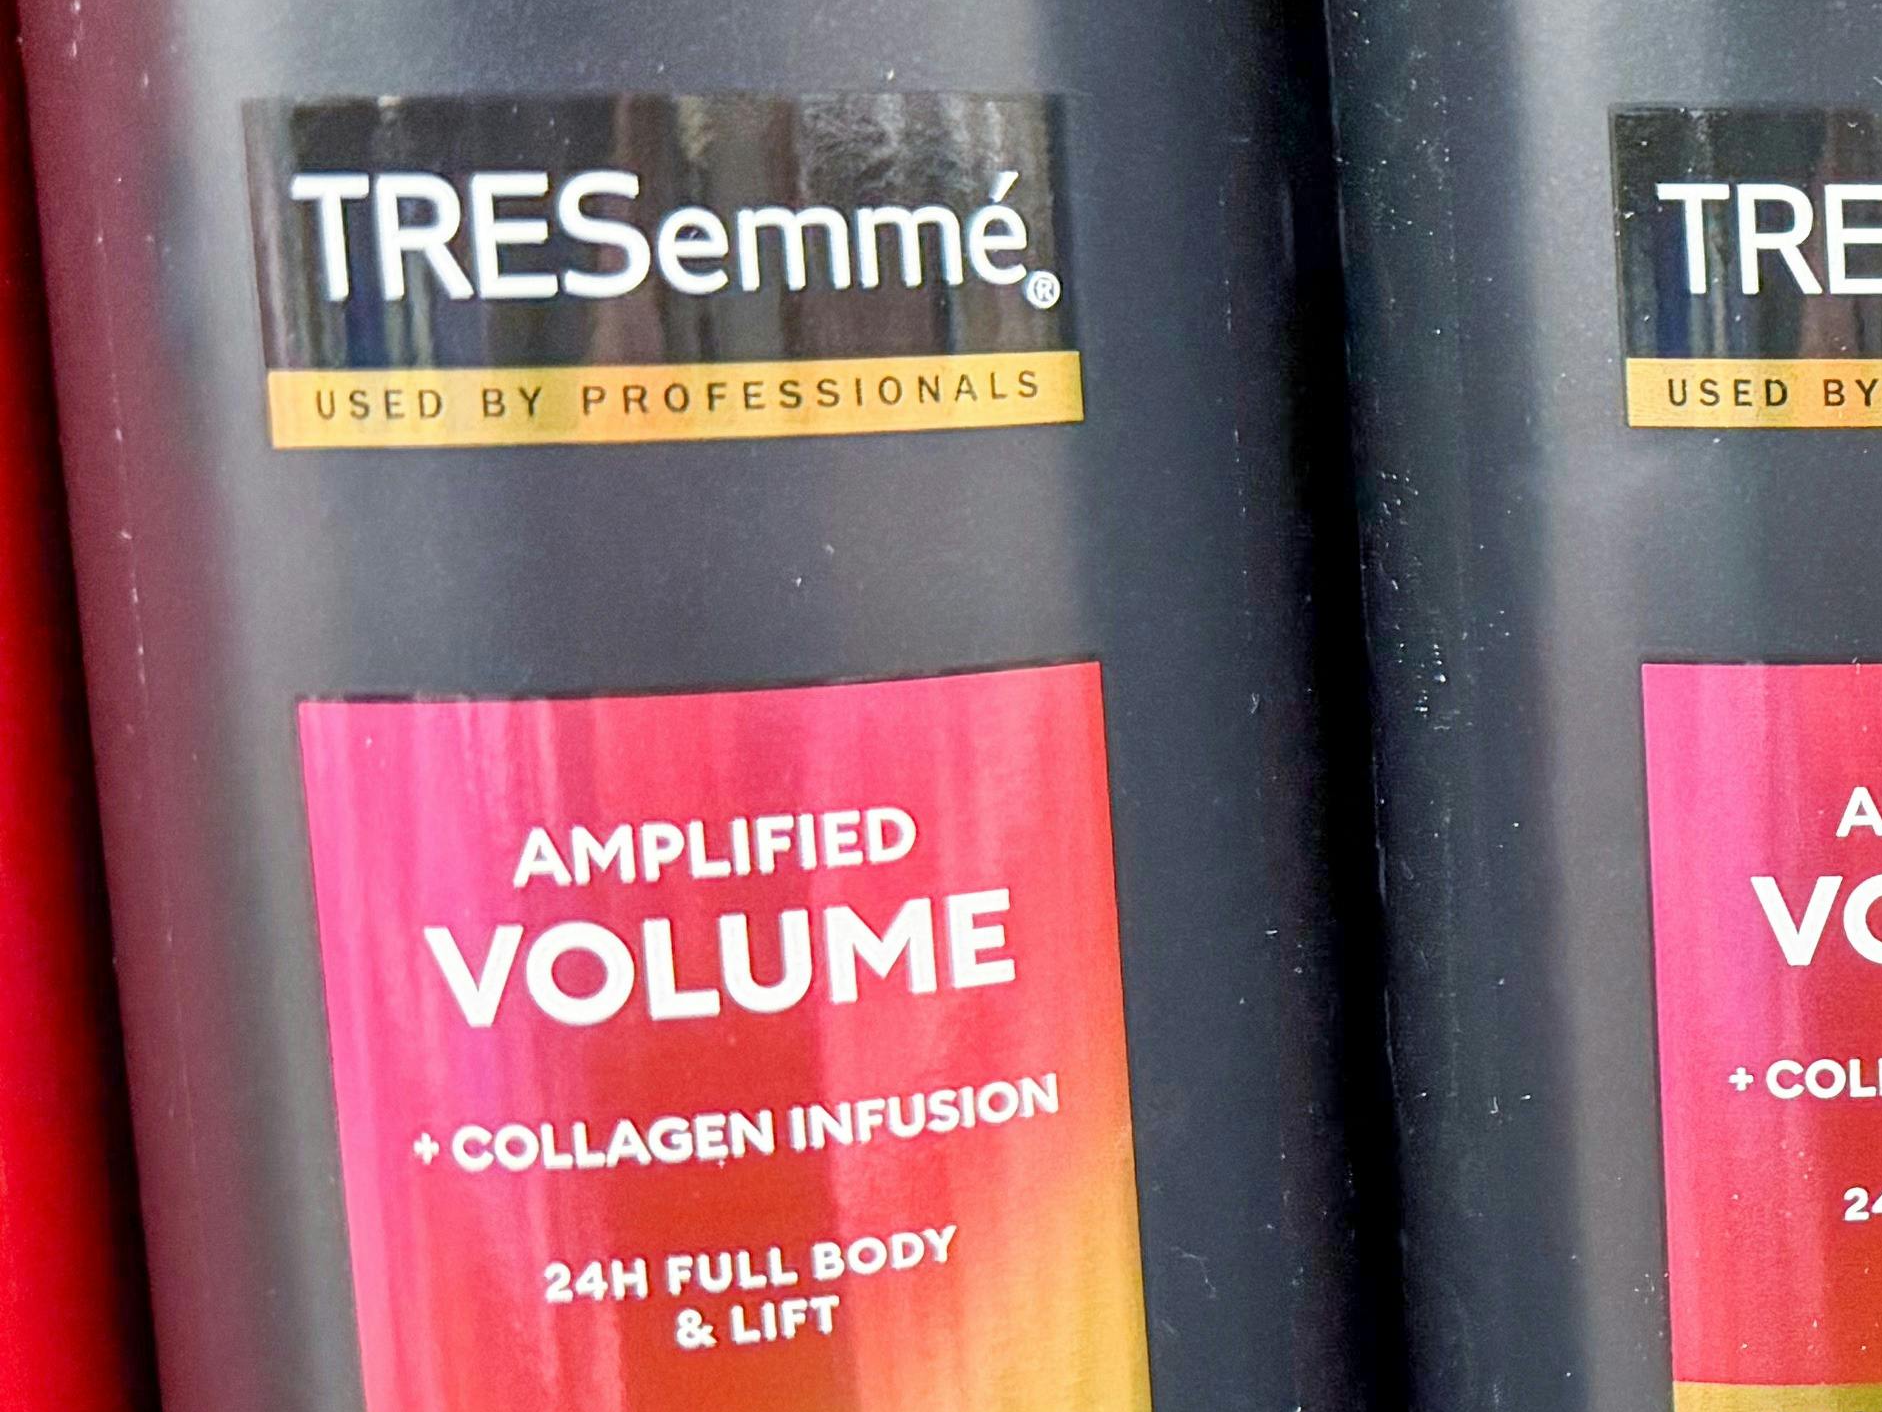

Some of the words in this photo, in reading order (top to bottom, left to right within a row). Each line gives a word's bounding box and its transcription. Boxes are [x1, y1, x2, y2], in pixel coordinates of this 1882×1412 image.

[315, 386, 446, 422] USED
[483, 384, 543, 419] BY
[581, 369, 1040, 417] PROFESSIONALS
[1667, 379, 1790, 408] USED
[1824, 378, 1879, 407] BY
[513, 806, 917, 888] AMPLIFIED
[425, 888, 1017, 1028] VOLUME
[792, 1073, 1060, 1151] INFUSION
[544, 1258, 648, 1303] 24H
[668, 1247, 797, 1296] FULL
[812, 1225, 957, 1281] BODY
[676, 1311, 715, 1348] &
[733, 1294, 841, 1344] LIFT
